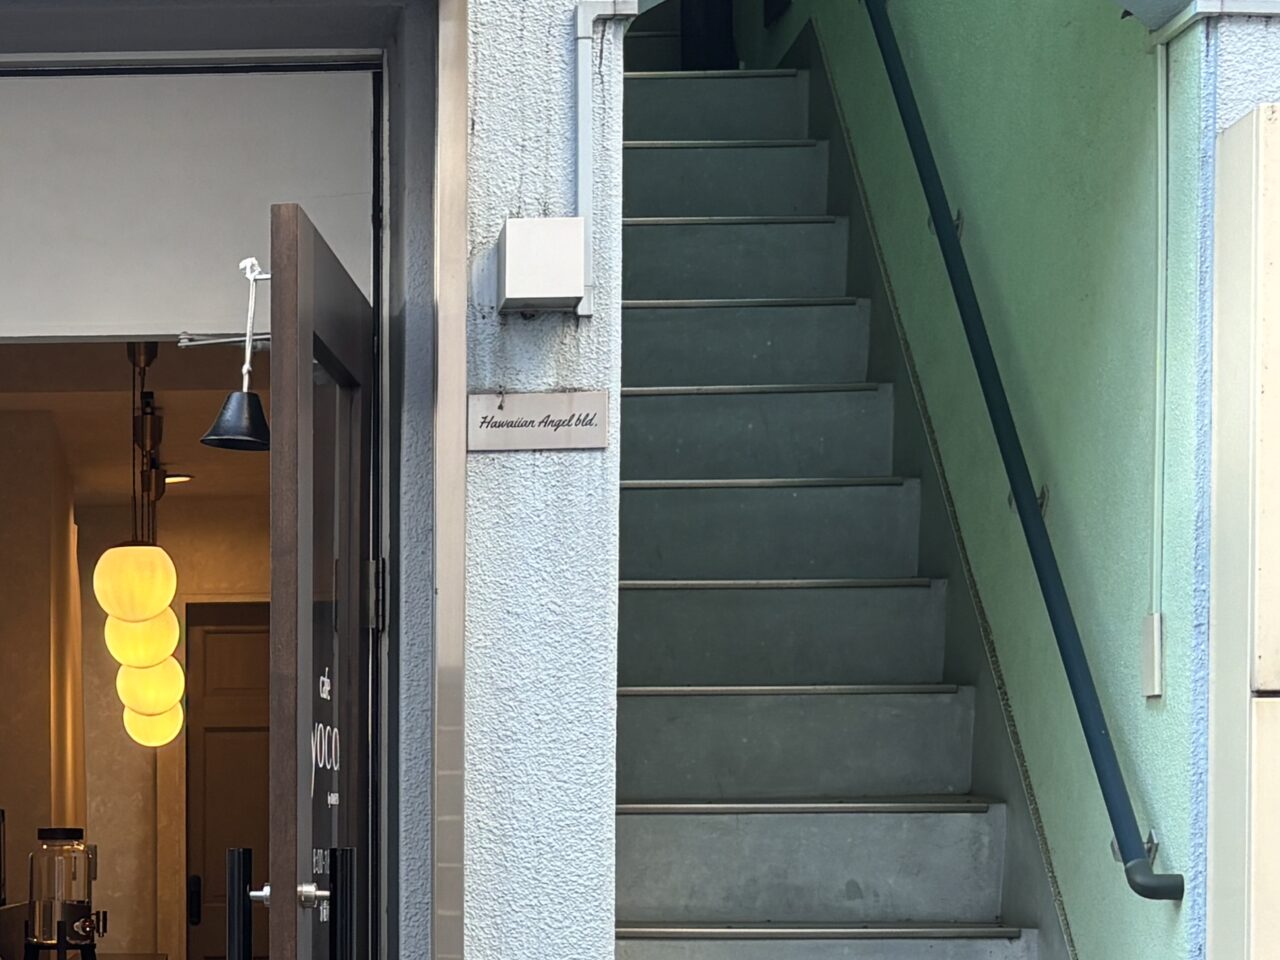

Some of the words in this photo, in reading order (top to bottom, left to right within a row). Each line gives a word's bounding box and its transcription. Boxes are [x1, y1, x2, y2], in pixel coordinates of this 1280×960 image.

[479, 415, 536, 429] Hawaiian
[537, 413, 576, 432] Angel
[574, 412, 599, 427] bld.
